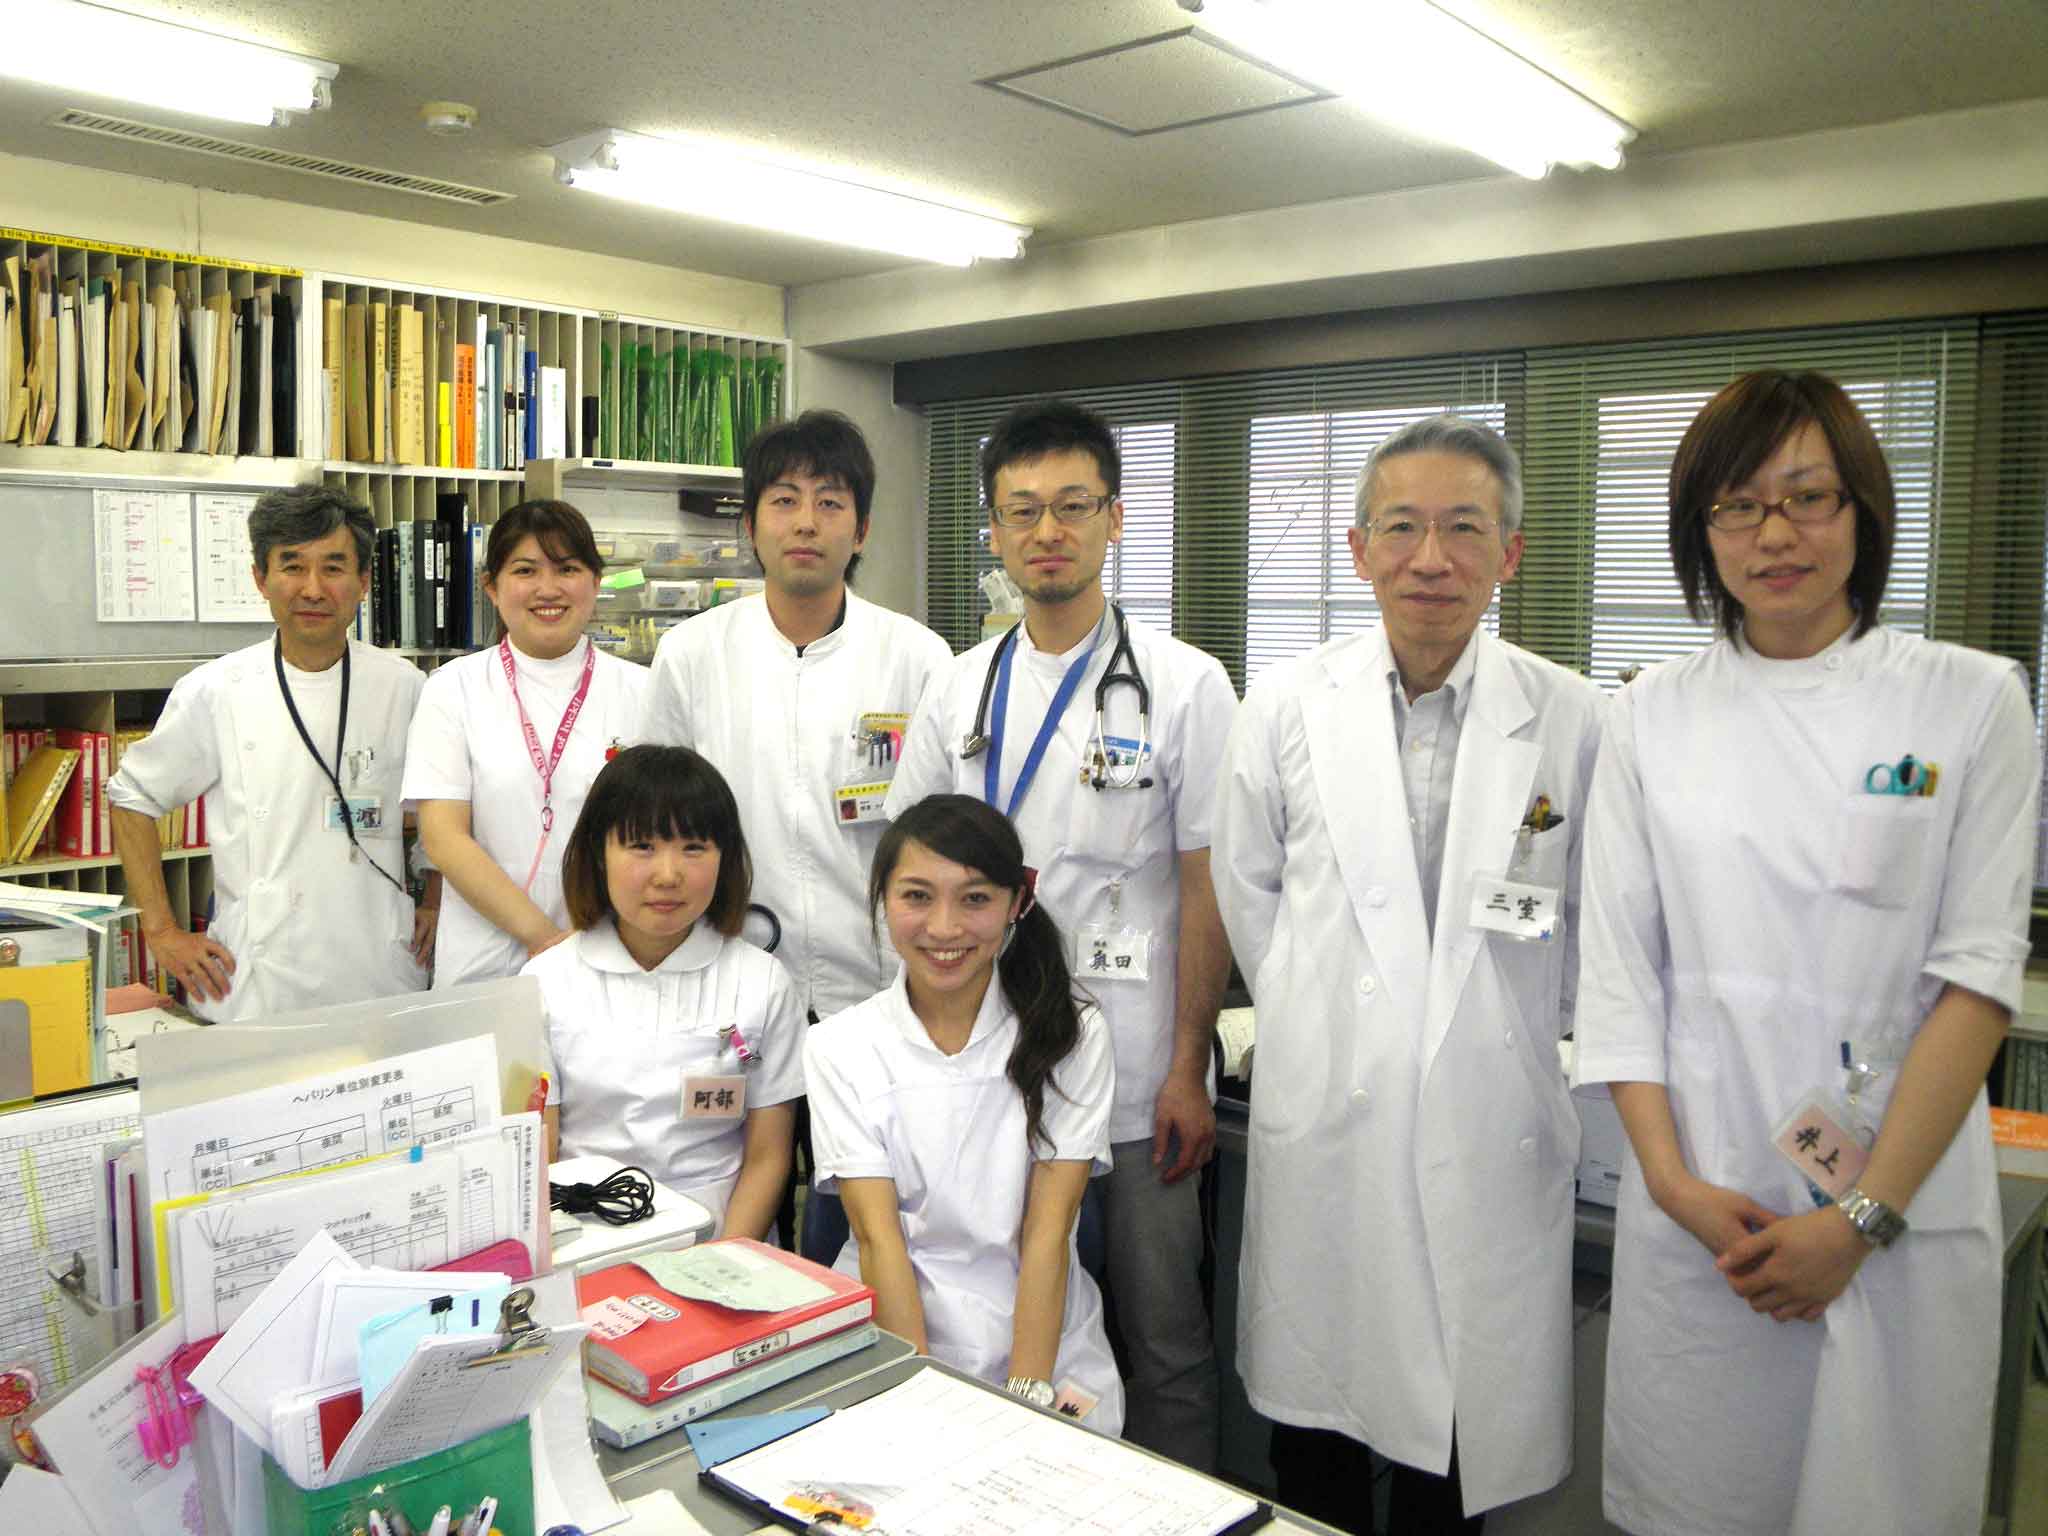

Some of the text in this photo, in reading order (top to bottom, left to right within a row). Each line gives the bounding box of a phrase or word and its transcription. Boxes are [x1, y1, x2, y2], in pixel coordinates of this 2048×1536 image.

[292, 1069, 404, 1102] ヘパリン単位別変更表
[383, 1092, 413, 1108] 火曜日
[693, 1088, 735, 1110] 阿部
[194, 1137, 229, 1157] 月曜日
[1795, 1126, 1839, 1176] 井上
